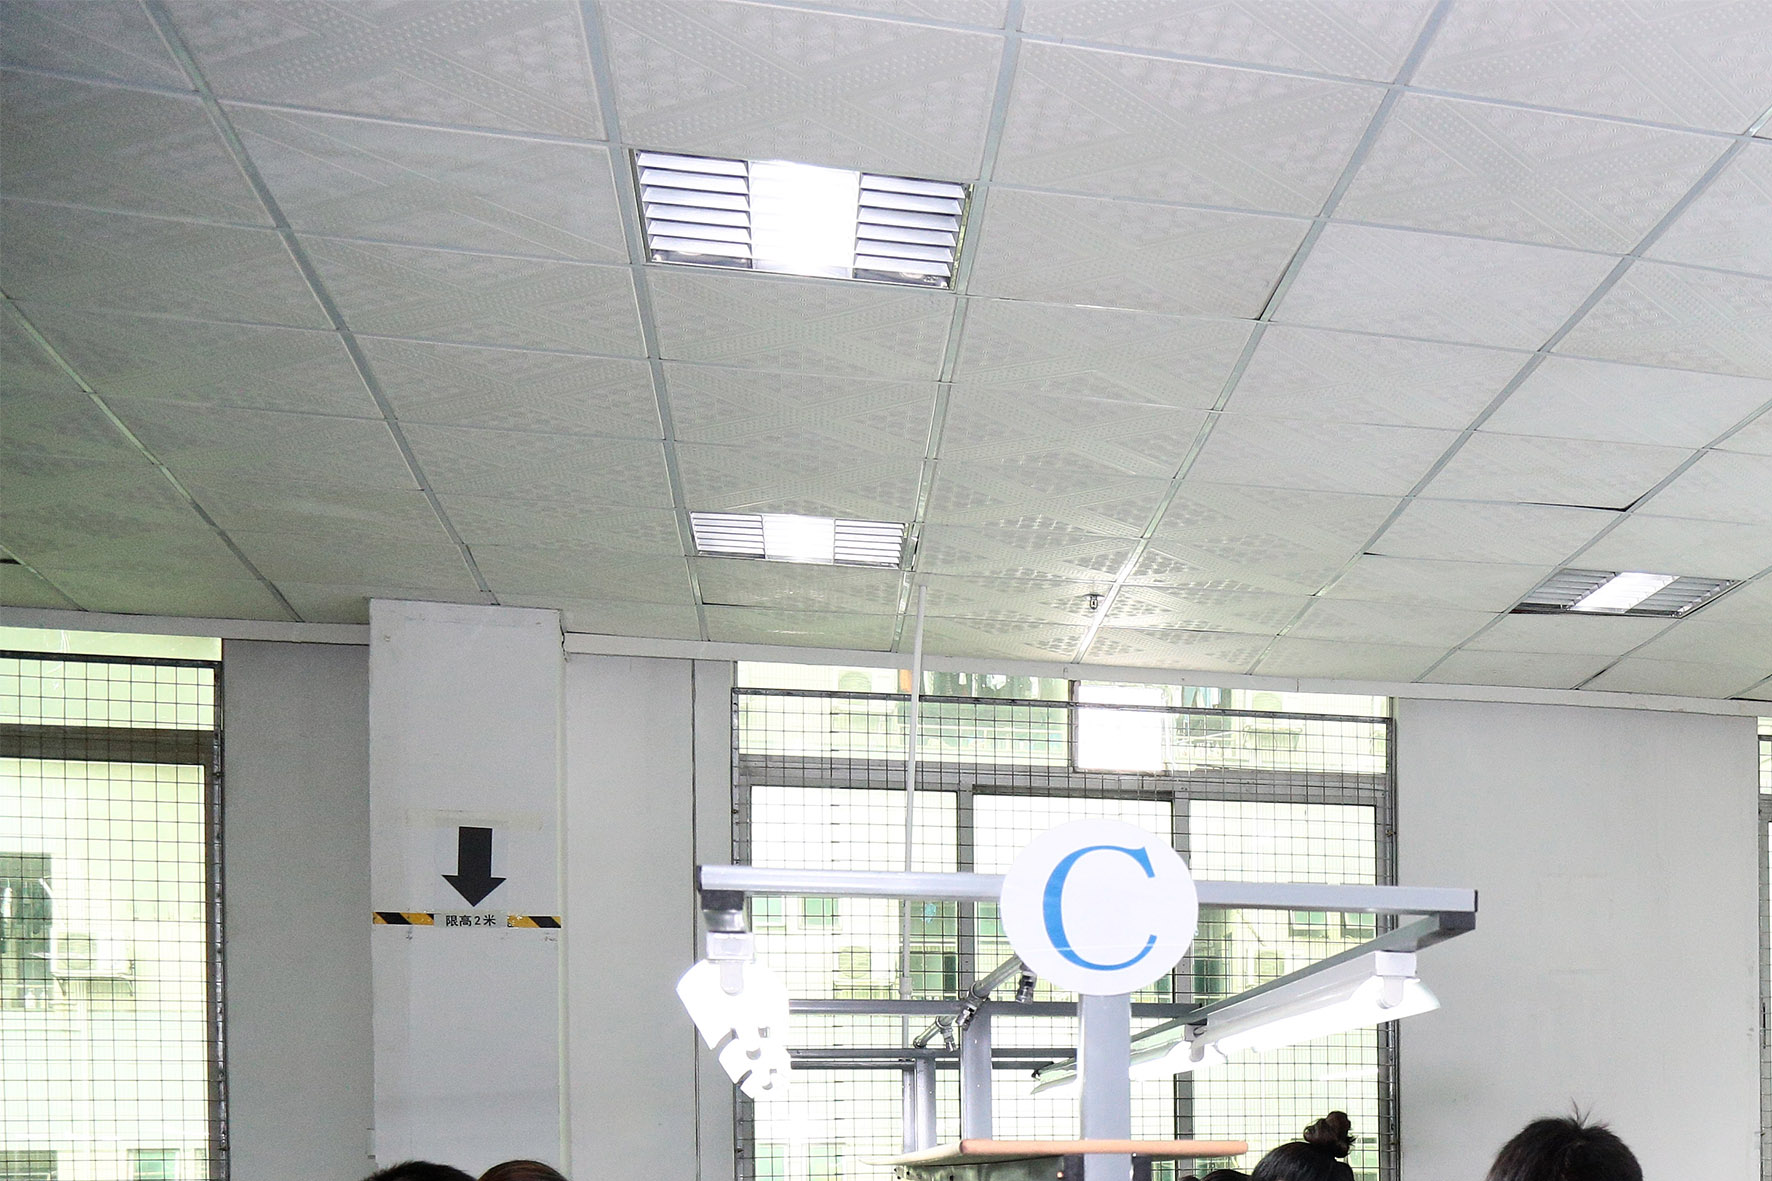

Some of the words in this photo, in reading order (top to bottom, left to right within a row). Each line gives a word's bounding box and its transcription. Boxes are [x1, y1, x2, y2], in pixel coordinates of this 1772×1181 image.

[445, 914, 497, 927] 限高2米
[1042, 845, 1158, 971] C
